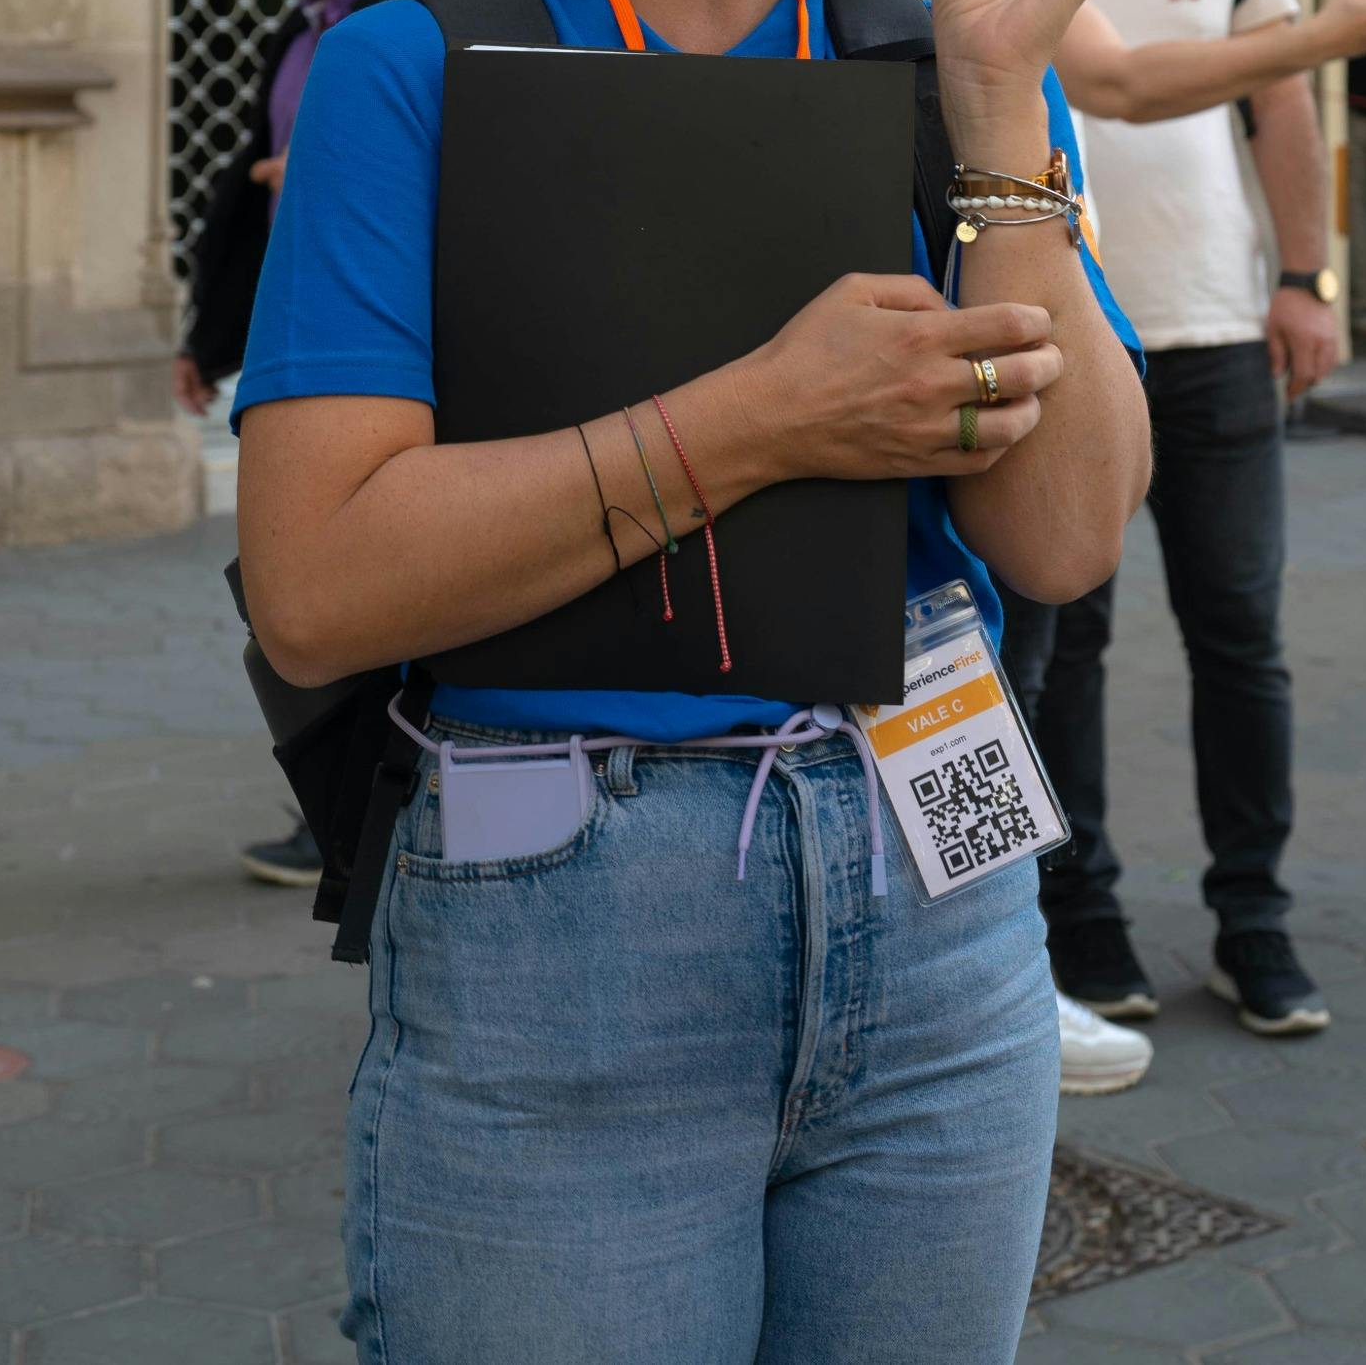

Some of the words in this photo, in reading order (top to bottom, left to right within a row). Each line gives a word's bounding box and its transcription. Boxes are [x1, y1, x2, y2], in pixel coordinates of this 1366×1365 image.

[902, 651, 983, 697] perienceFirst
[907, 704, 950, 733] VALE
[951, 698, 964, 713] C
[930, 734, 967, 757] exp1.com
